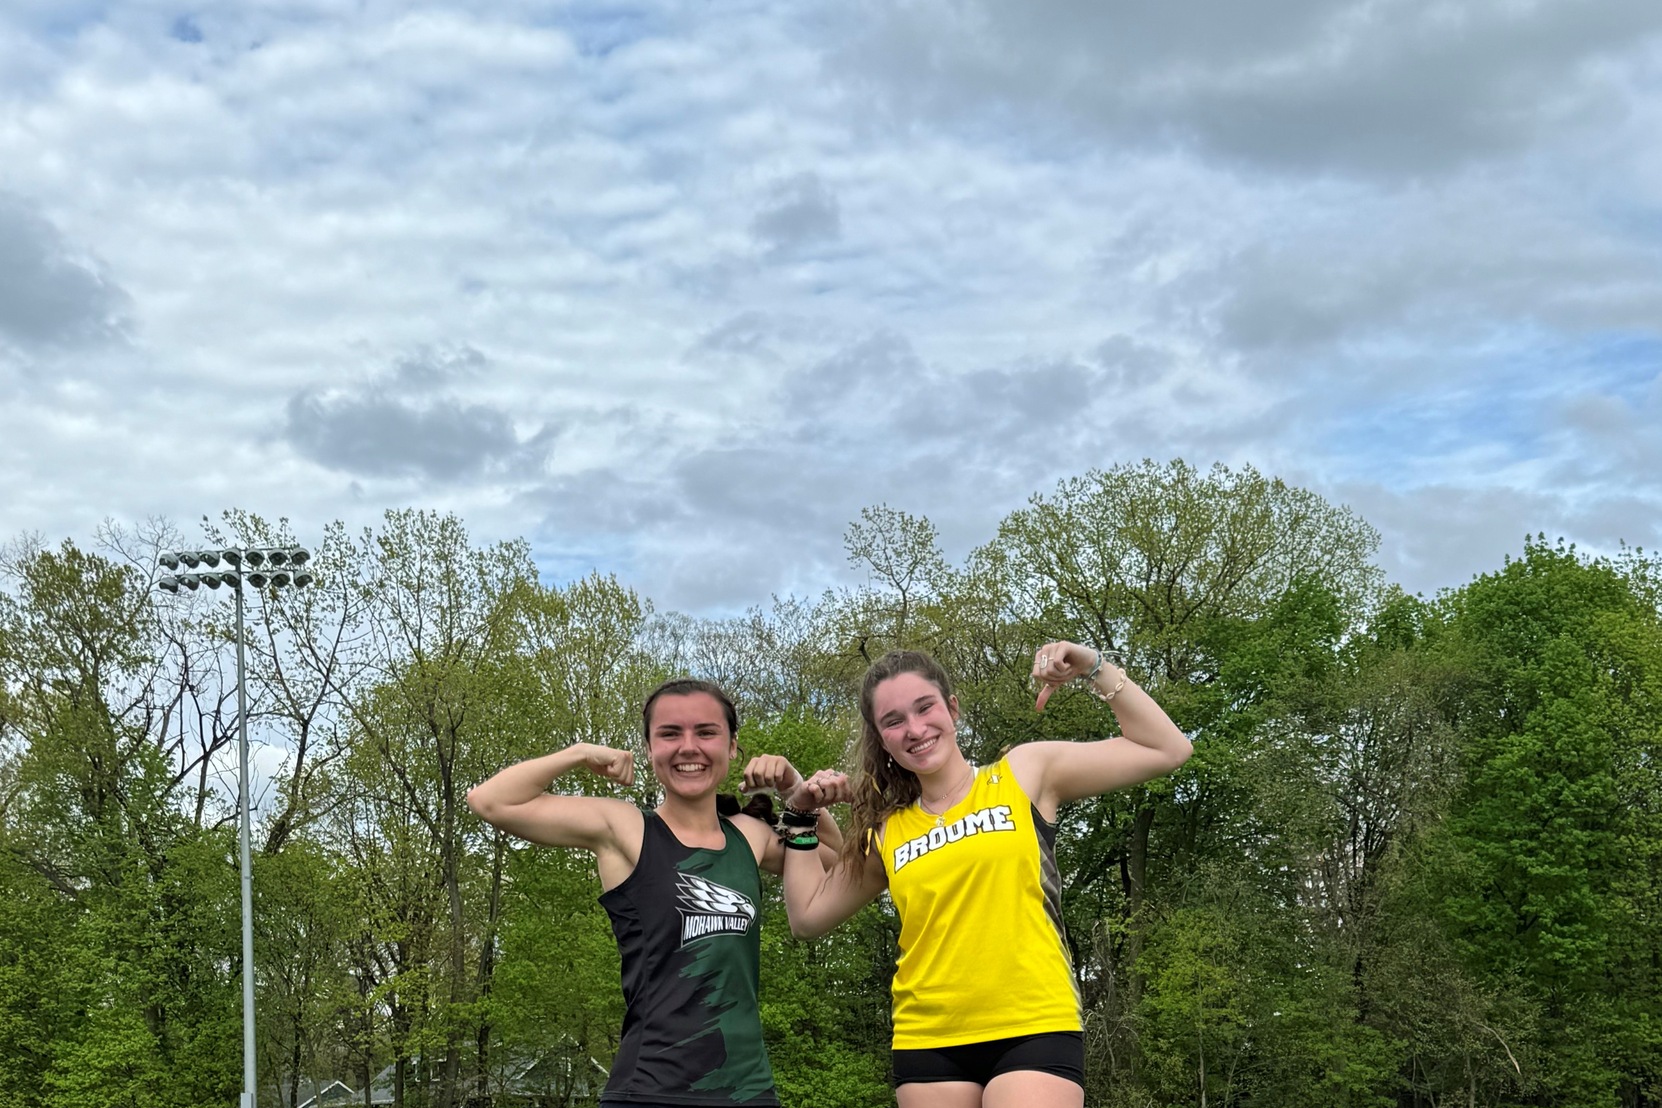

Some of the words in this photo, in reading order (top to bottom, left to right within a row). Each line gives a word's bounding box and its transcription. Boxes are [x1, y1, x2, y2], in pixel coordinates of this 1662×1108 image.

[894, 804, 1016, 874] BROOME
[684, 915, 724, 940] MOHAWK
[724, 916, 750, 932] VALLEY
